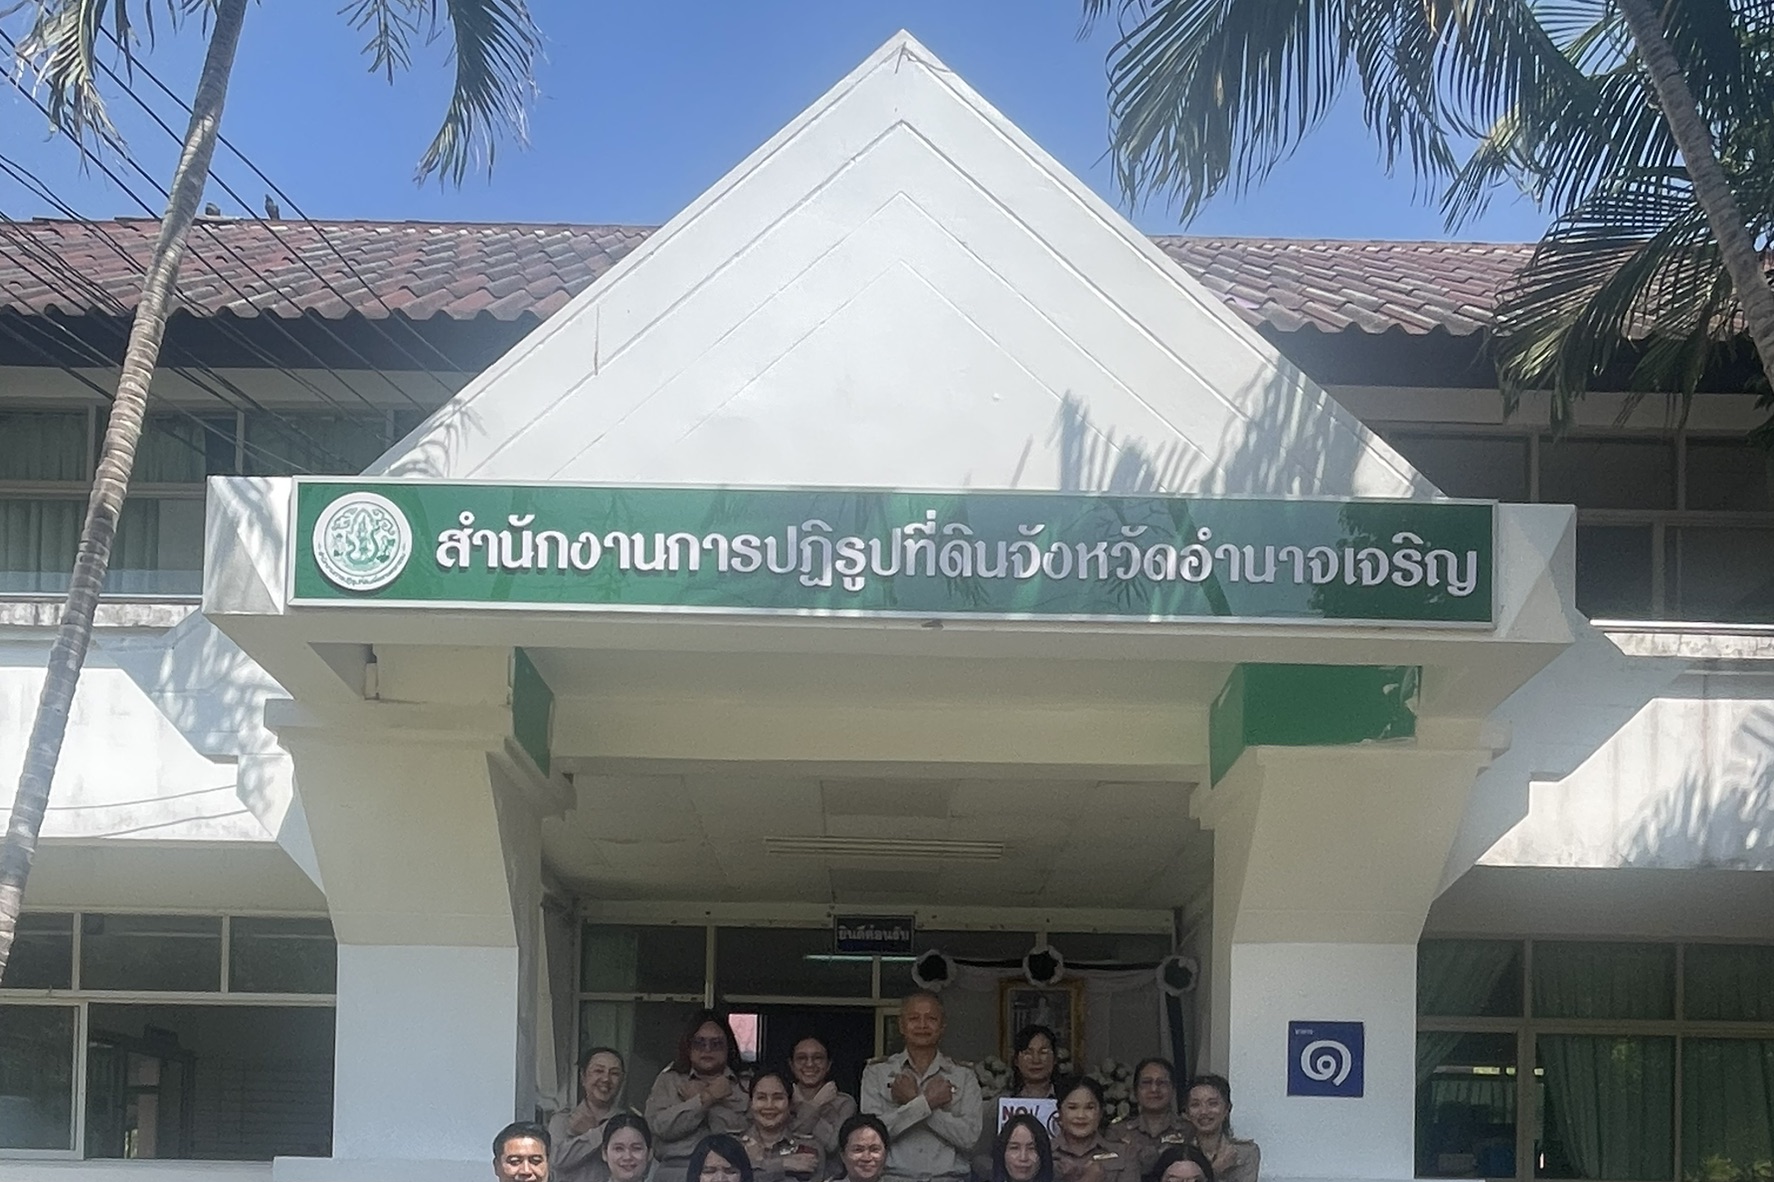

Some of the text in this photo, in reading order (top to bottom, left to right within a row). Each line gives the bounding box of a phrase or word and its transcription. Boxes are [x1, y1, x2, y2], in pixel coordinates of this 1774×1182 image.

[436, 509, 1478, 597] สำนักงานการปฏิรูปที่ดินจังหวัดอำนาจเจริญ
